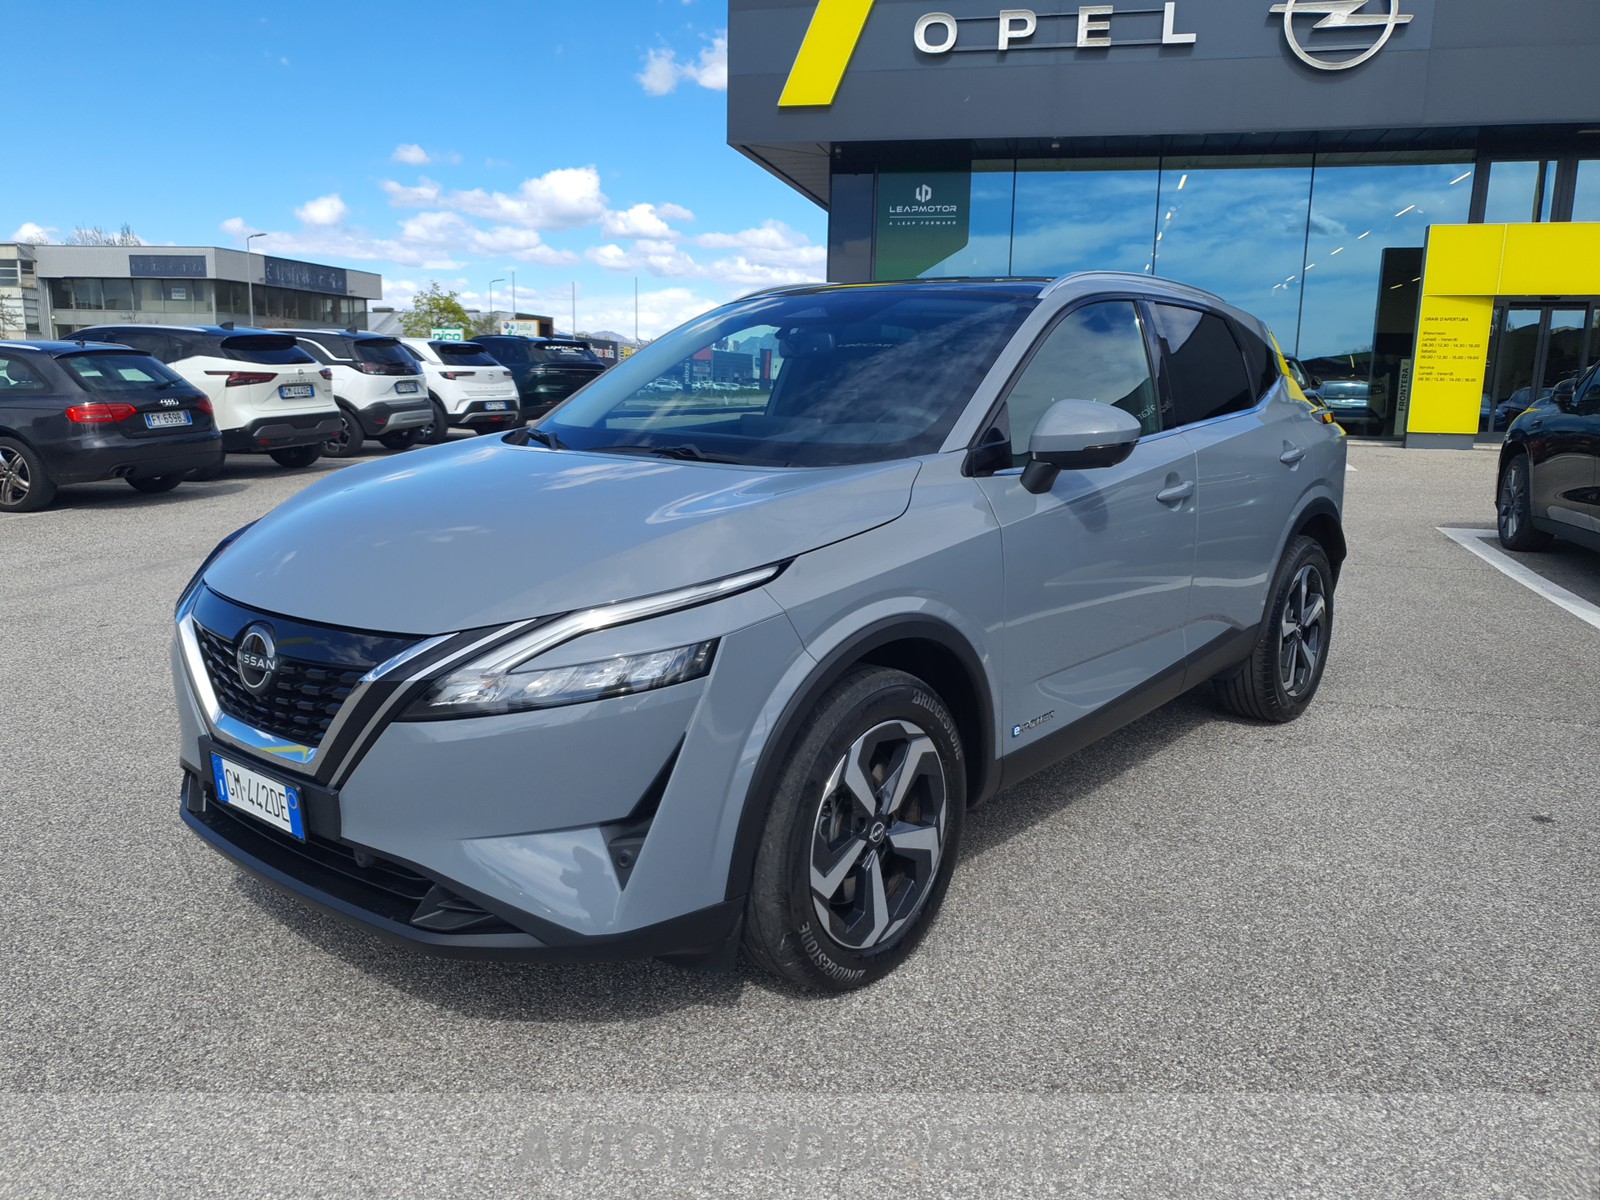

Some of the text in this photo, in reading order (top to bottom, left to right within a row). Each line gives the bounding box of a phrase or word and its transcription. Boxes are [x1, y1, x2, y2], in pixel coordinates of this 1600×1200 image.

[913, 1, 1197, 54] OPEL
[889, 205, 957, 213] LEAPMOTOR
[1398, 367, 1410, 412] FRONTERA
[238, 651, 276, 670] ISSAN
[911, 688, 963, 761] BRIDGESTONE
[799, 920, 867, 982] BRIDGESTONE
